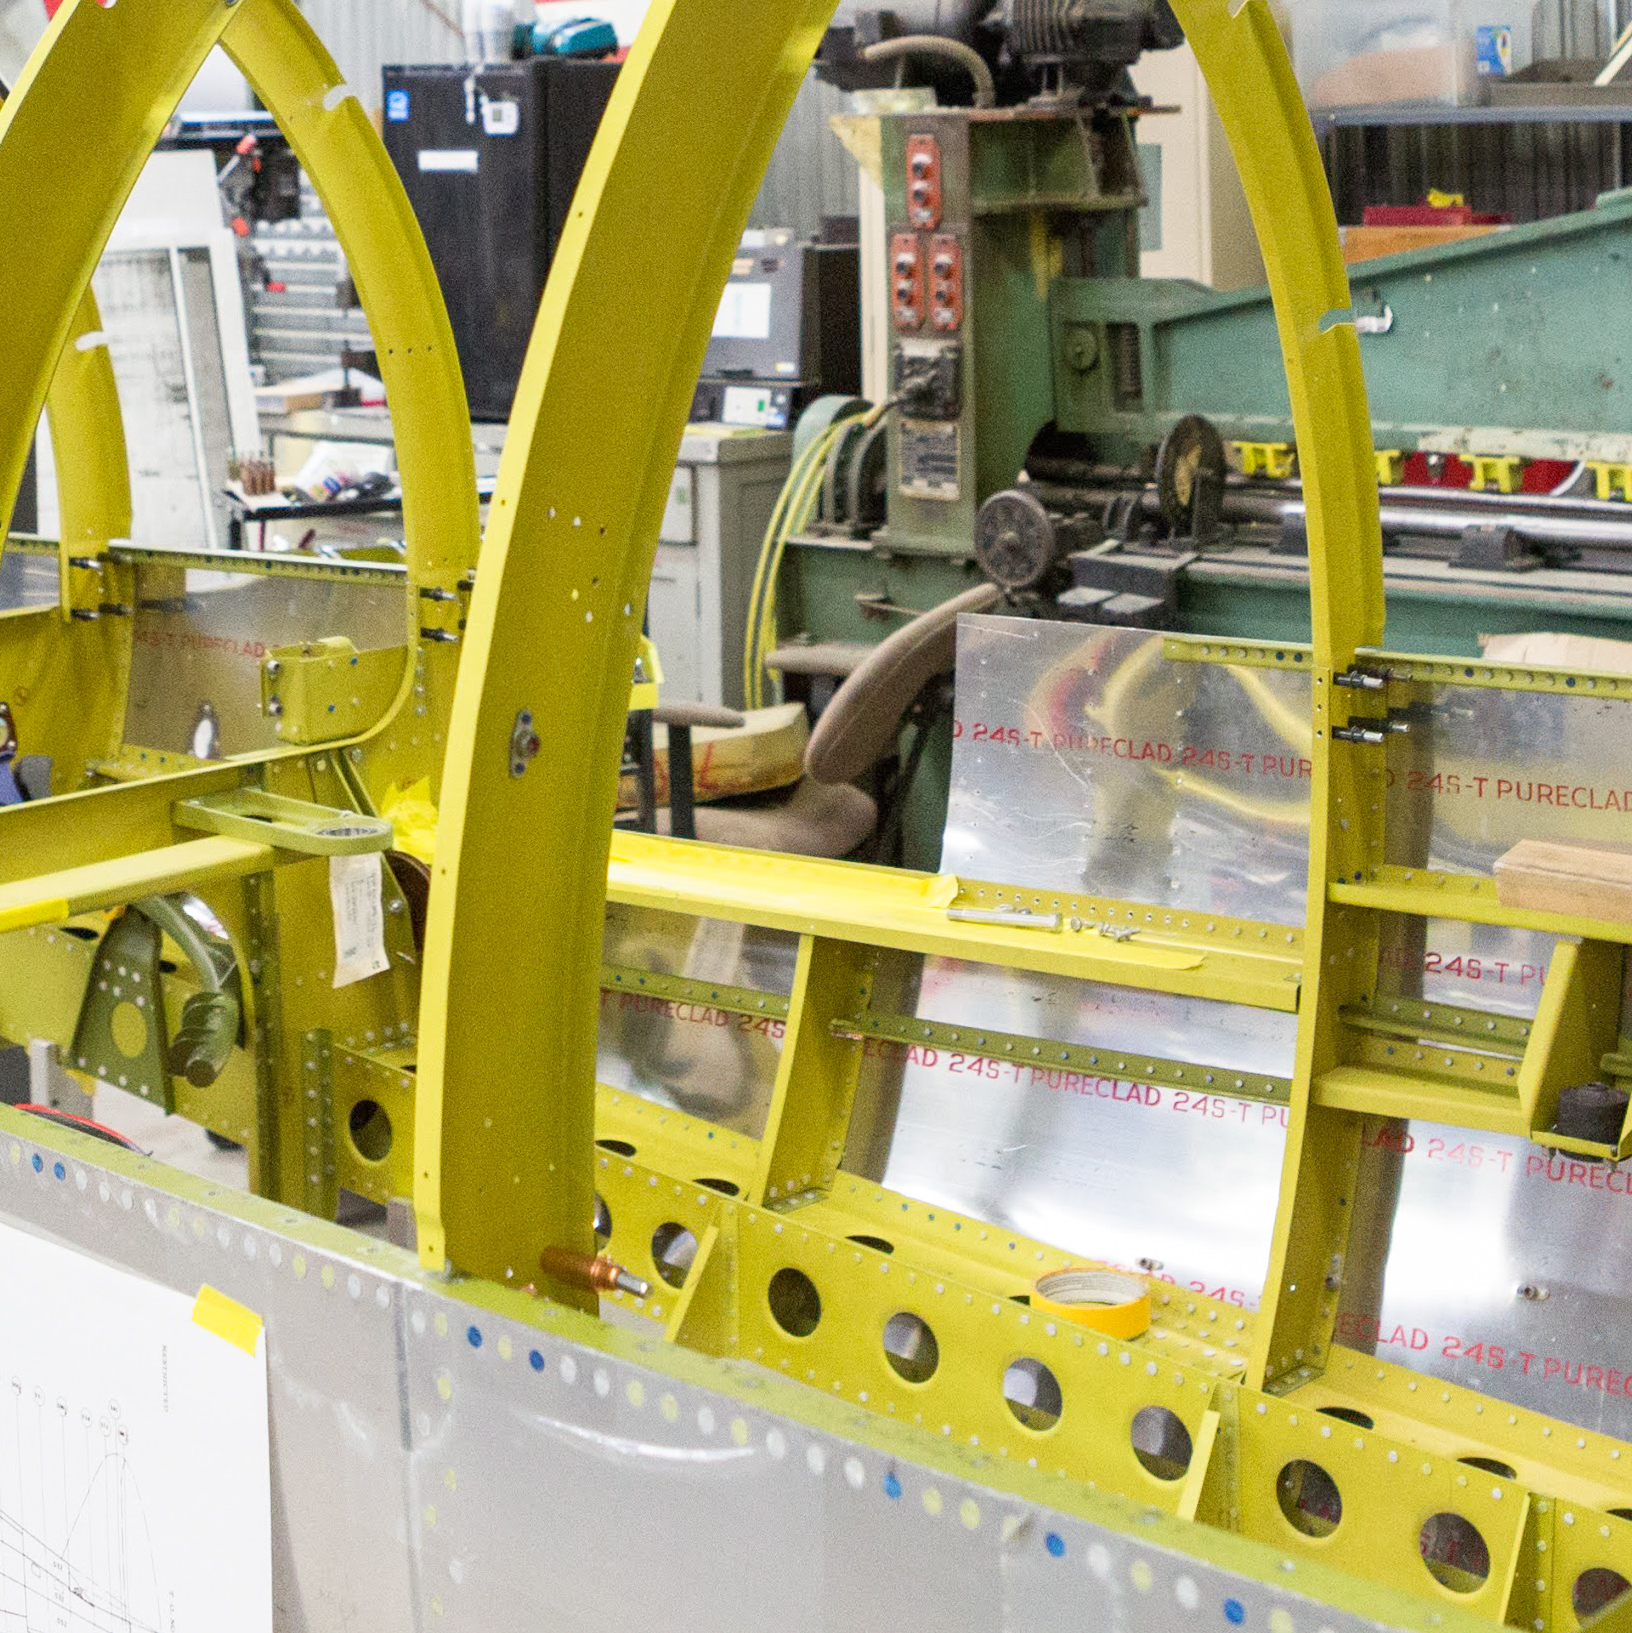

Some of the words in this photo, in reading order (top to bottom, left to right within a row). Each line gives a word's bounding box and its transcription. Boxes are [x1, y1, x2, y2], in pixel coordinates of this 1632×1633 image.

[1407, 769, 1489, 799] 24S-T
[1424, 951, 1509, 984] 24S-T
[949, 1052, 1025, 1085] 24S-T
[1031, 1069, 1162, 1108] PURECLAD
[1172, 1091, 1255, 1124] 24S-T
[1427, 1137, 1514, 1174] 24S-T
[1441, 1334, 1536, 1378] 24S-T
